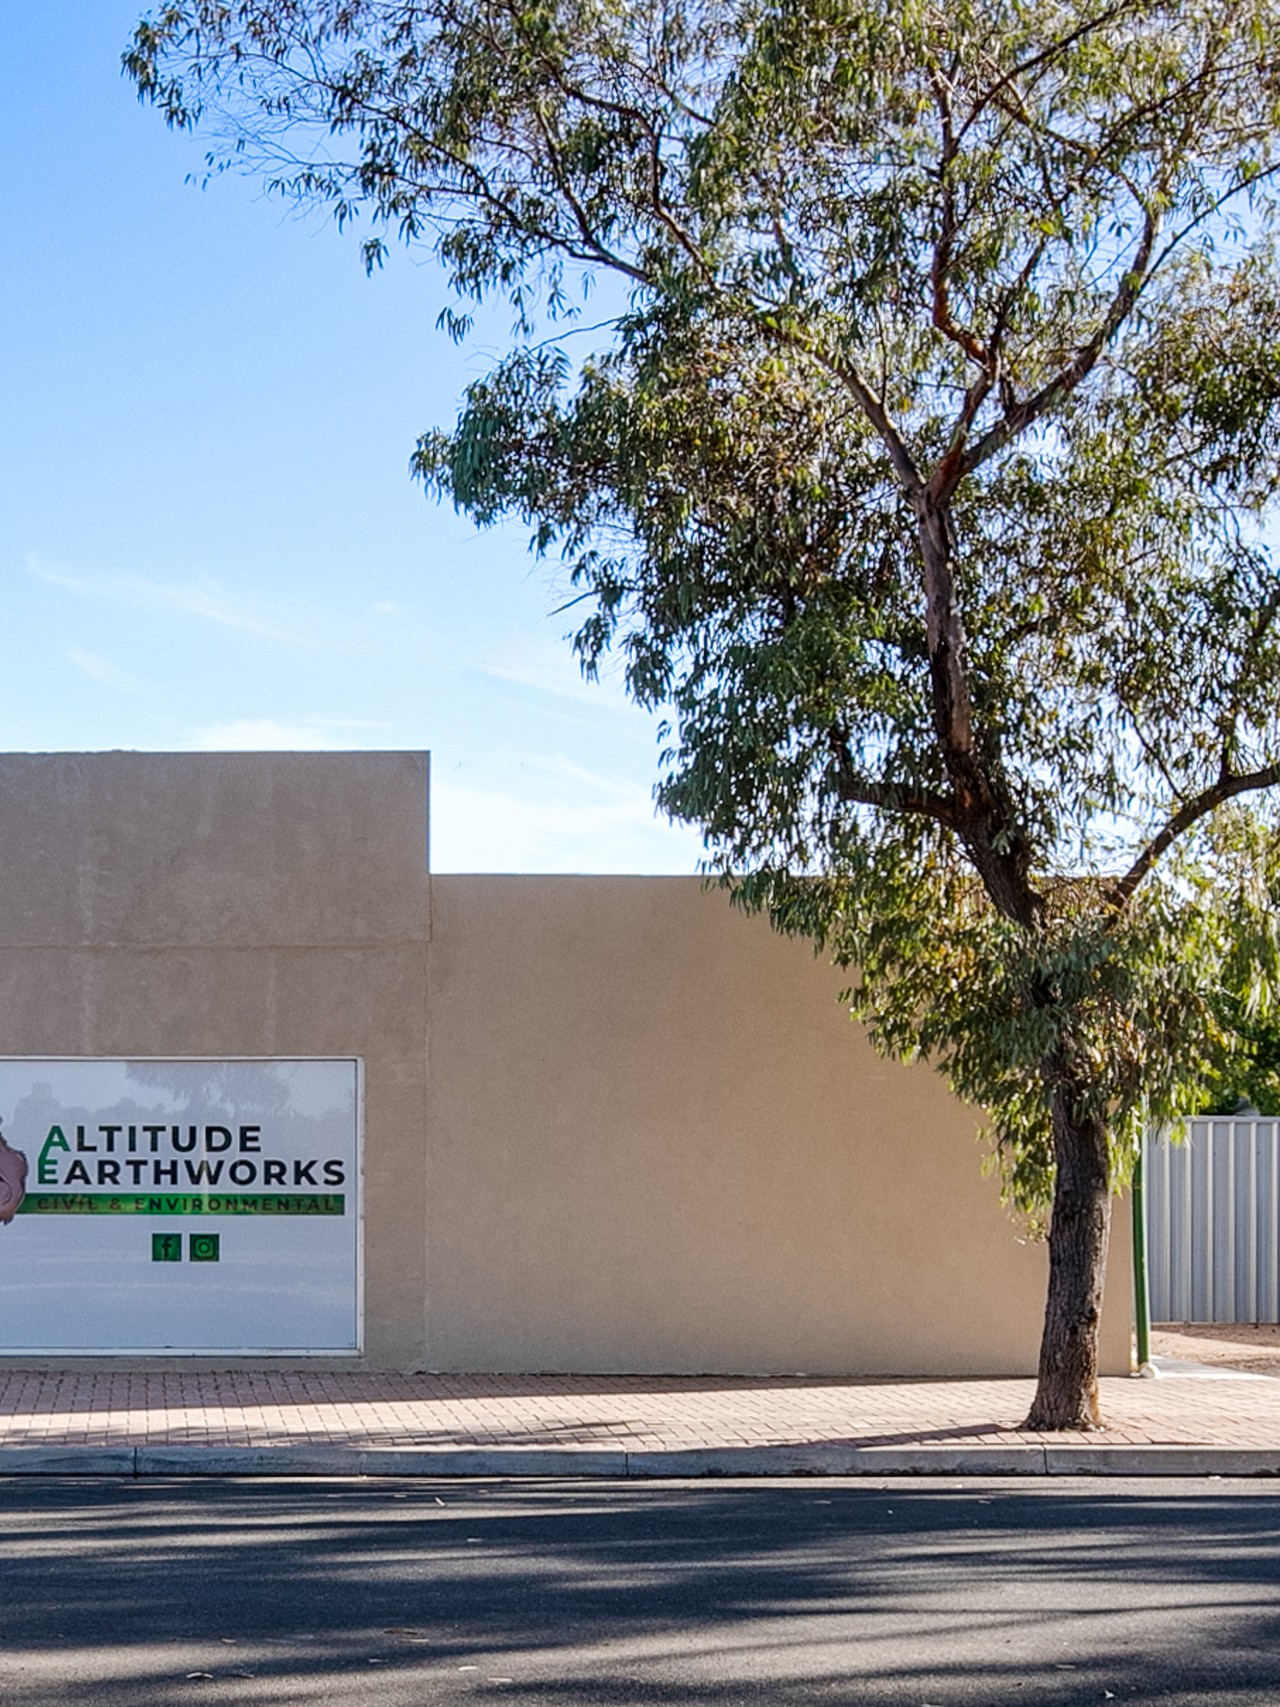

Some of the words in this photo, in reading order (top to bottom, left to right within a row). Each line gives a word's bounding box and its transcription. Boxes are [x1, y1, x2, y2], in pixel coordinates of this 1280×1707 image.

[42, 1125, 261, 1152] ALTITUDE
[37, 1159, 345, 1185] EARTHWORKS
[37, 1197, 98, 1210] CIVIL
[110, 1197, 122, 1210] &
[135, 1197, 334, 1211] ENVIRONMENTAL
